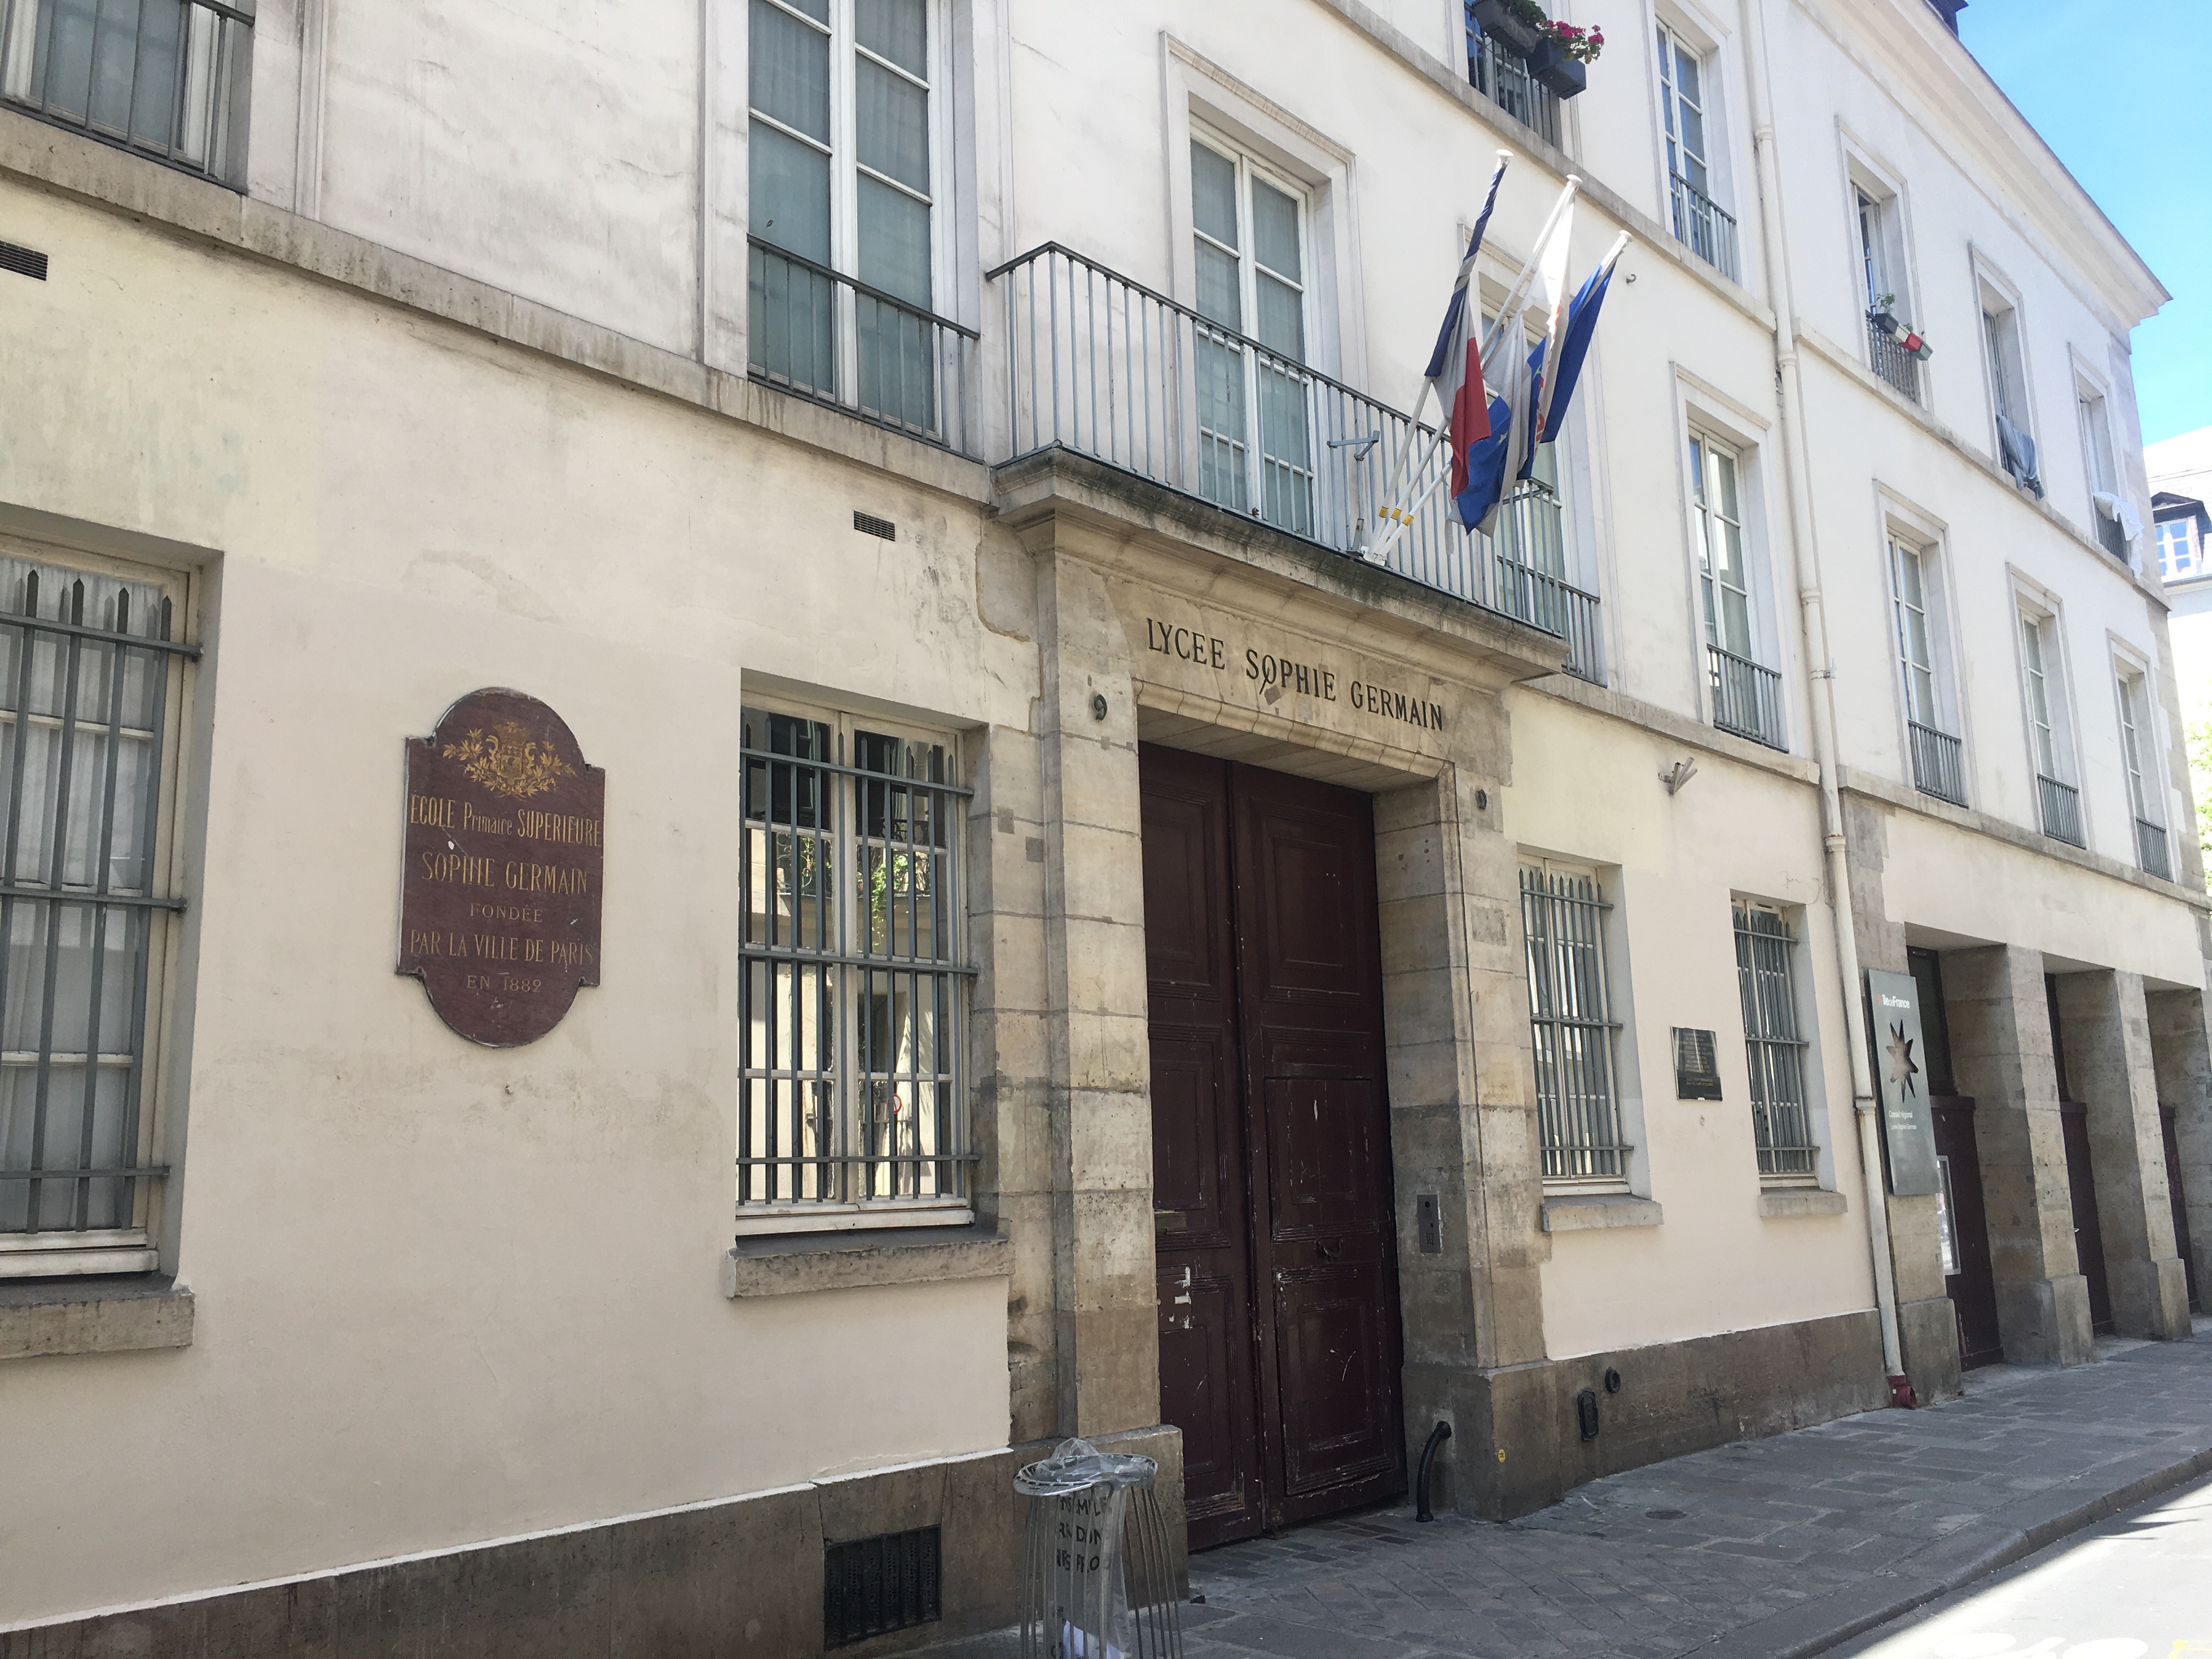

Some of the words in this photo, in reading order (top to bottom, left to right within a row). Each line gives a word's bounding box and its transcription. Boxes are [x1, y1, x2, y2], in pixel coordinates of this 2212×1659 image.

[1146, 618, 1226, 670] LYCEE
[1246, 648, 1336, 702] SOPHIE
[1351, 680, 1443, 731] GERMAIN
[1093, 694, 1108, 721] 9
[464, 802, 512, 836] Primaire
[422, 851, 495, 887] SOPHIE
[506, 861, 587, 895] GERMAIN
[470, 903, 543, 923] FONDÉE
[410, 930, 441, 955] PAR
[449, 933, 467, 957] LA
[475, 934, 518, 961] VILLE
[525, 938, 544, 962] DE
[551, 941, 593, 965] PARIS
[467, 975, 490, 989] EN
[504, 976, 541, 992] 1882
